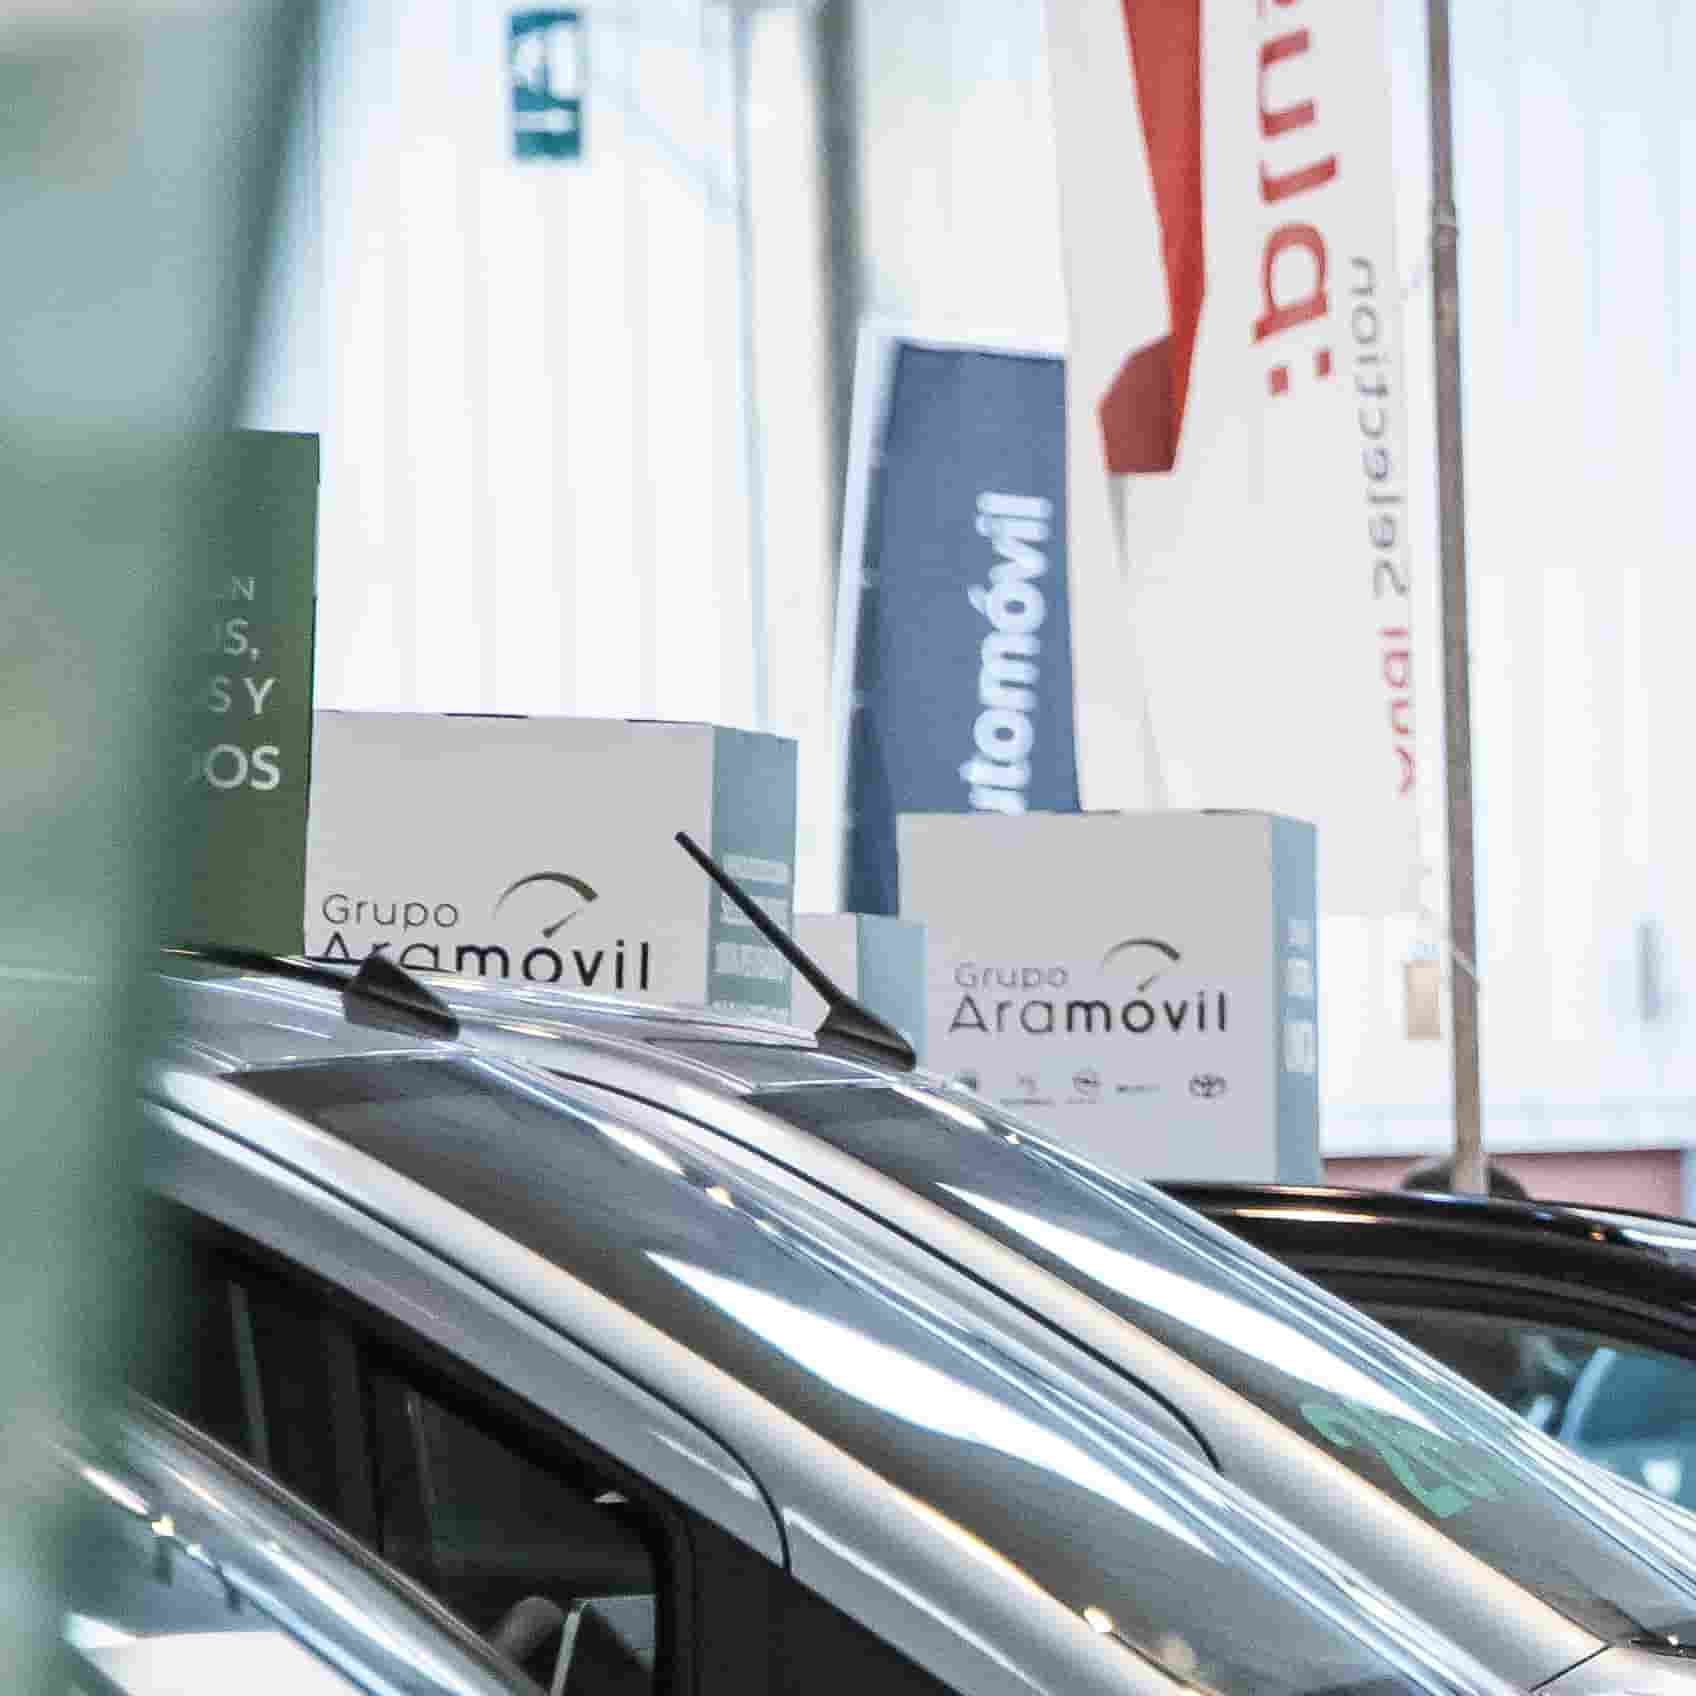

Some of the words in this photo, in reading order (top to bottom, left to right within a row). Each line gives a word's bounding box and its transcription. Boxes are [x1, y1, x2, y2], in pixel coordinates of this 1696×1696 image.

[321, 893, 458, 932] Grupo
[954, 962, 1068, 990] Grupo
[949, 988, 1227, 1034] Aramóvil
